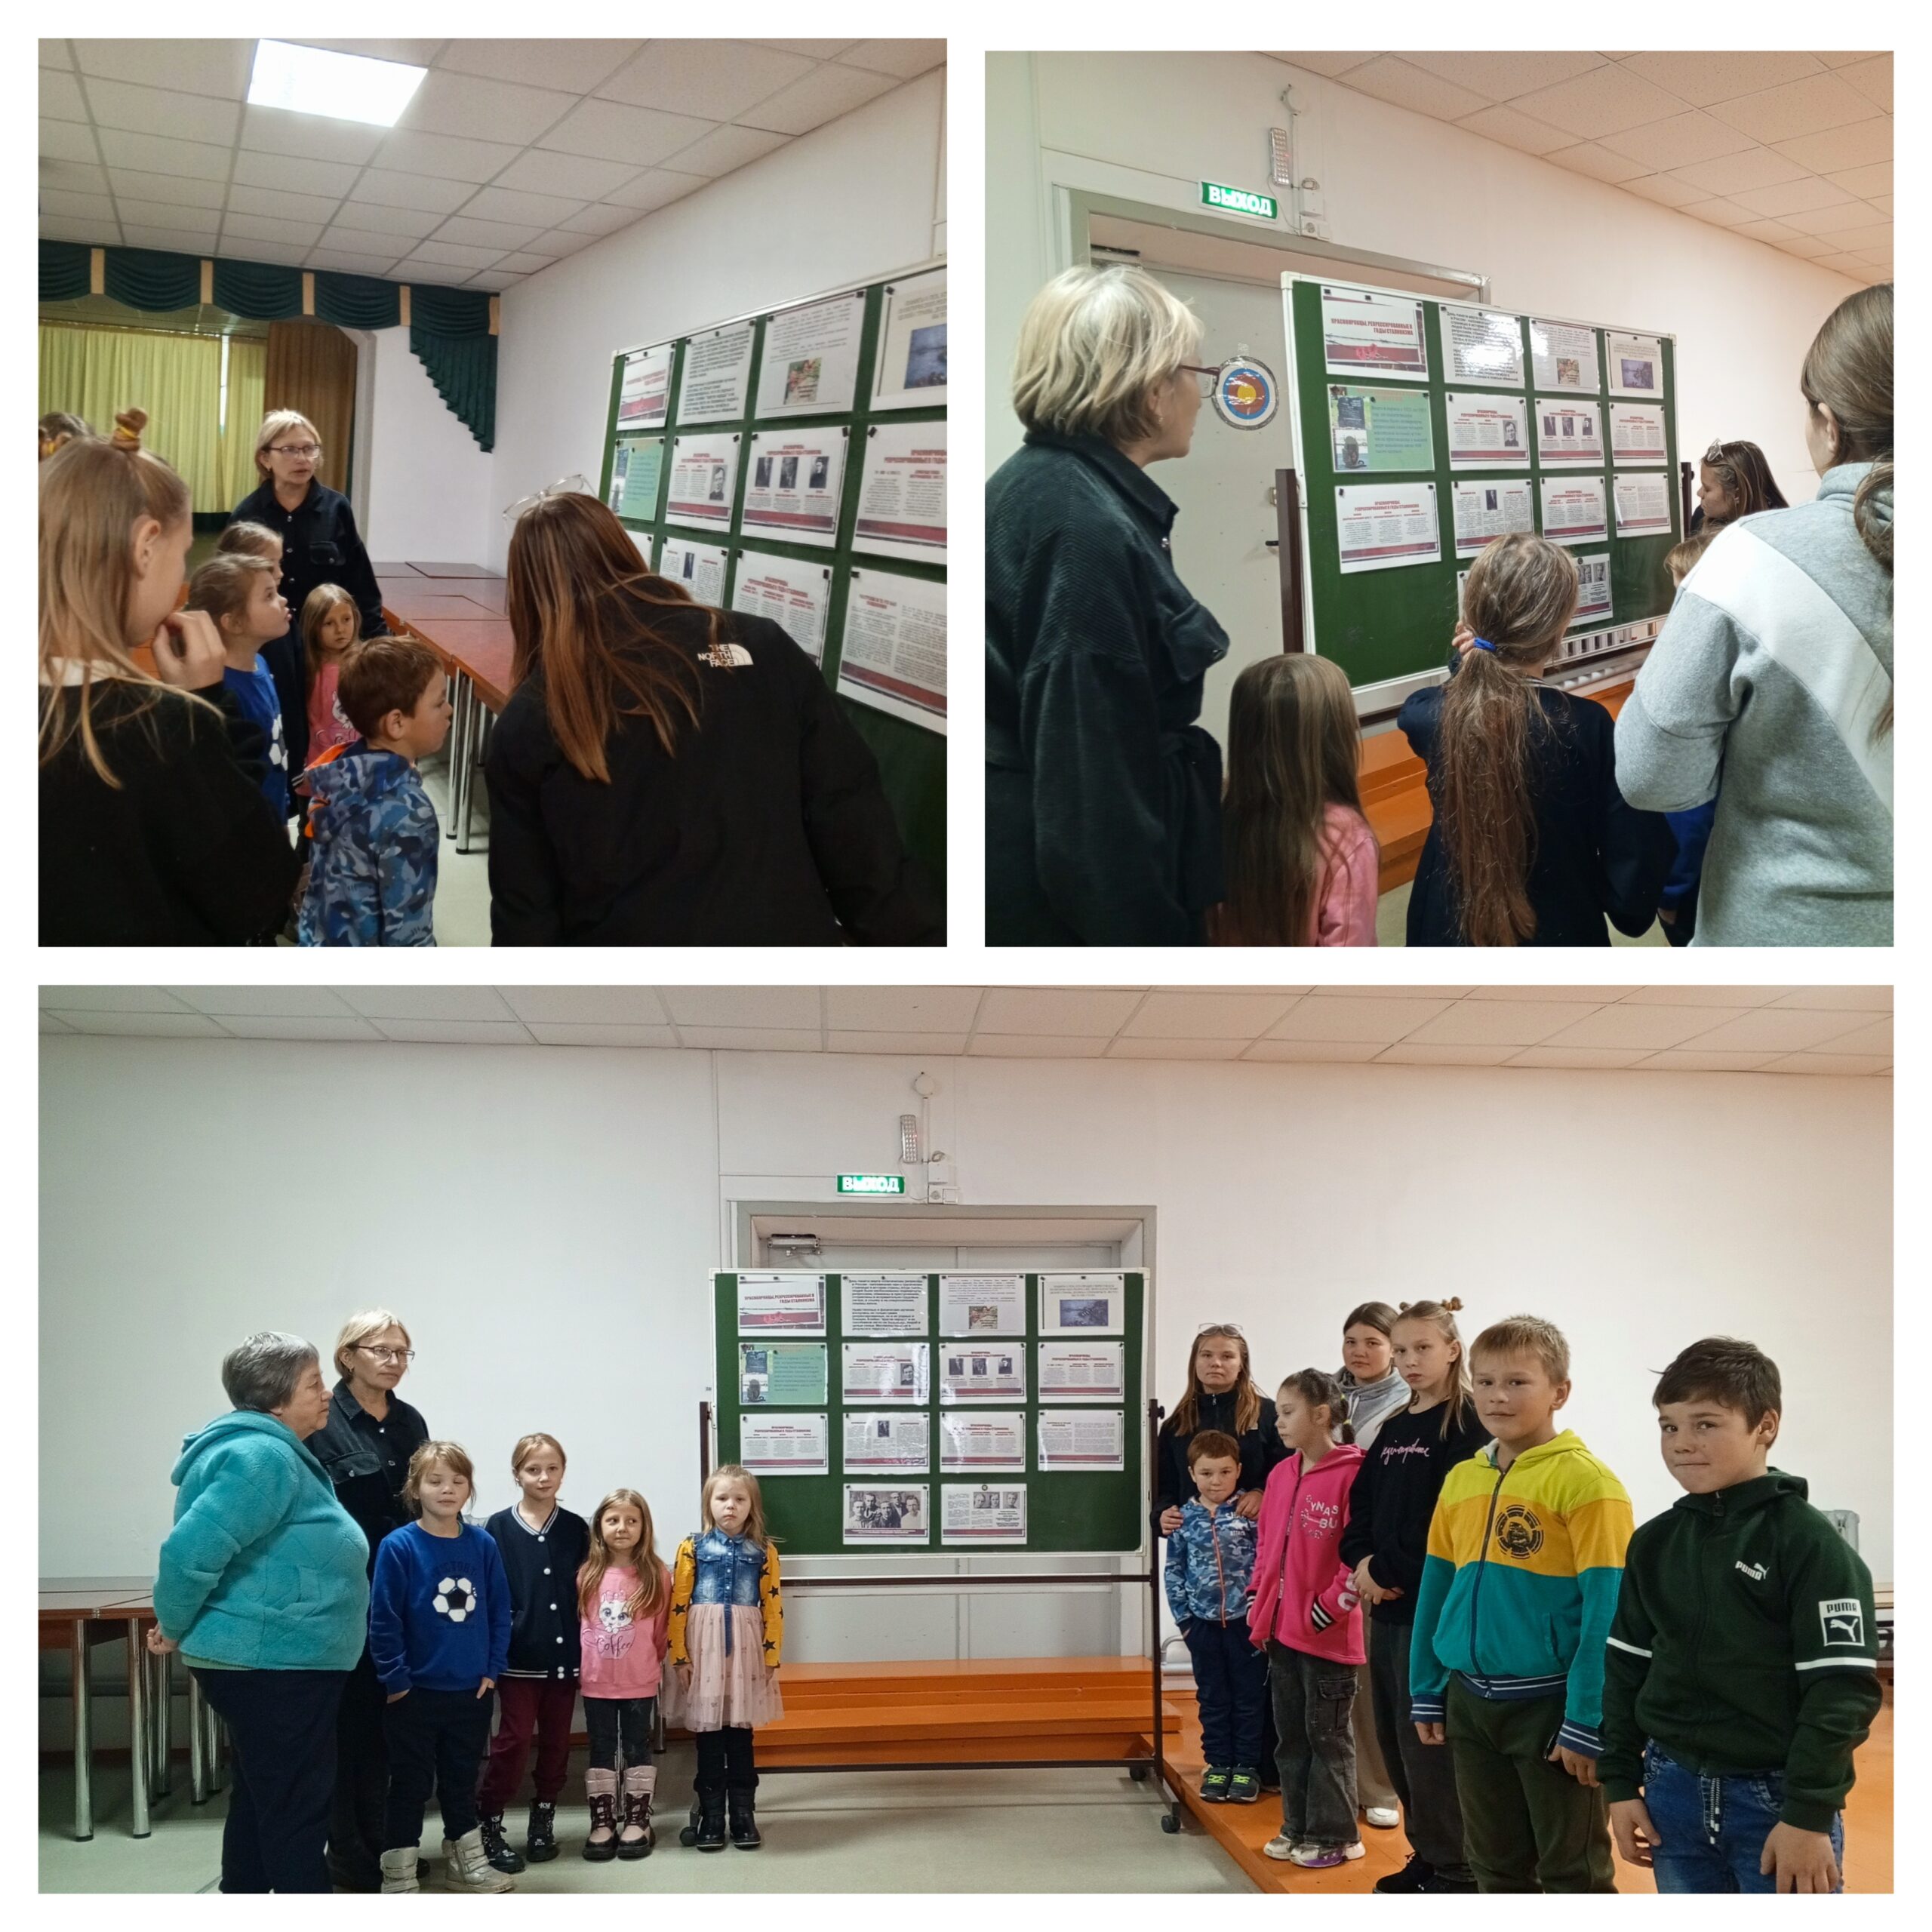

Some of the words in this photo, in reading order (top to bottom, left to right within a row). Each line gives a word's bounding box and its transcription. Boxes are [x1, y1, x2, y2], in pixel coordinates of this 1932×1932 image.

[1208, 185, 1272, 217] ВЫХОД
[697, 651, 733, 661] NORTH
[709, 658, 734, 668] FACE
[842, 1177, 900, 1192] ВЫХОД
[1735, 1560, 1763, 1581] PUMA
[1826, 1602, 1857, 1614] PUMA
[596, 1633, 632, 1657] Coffee
